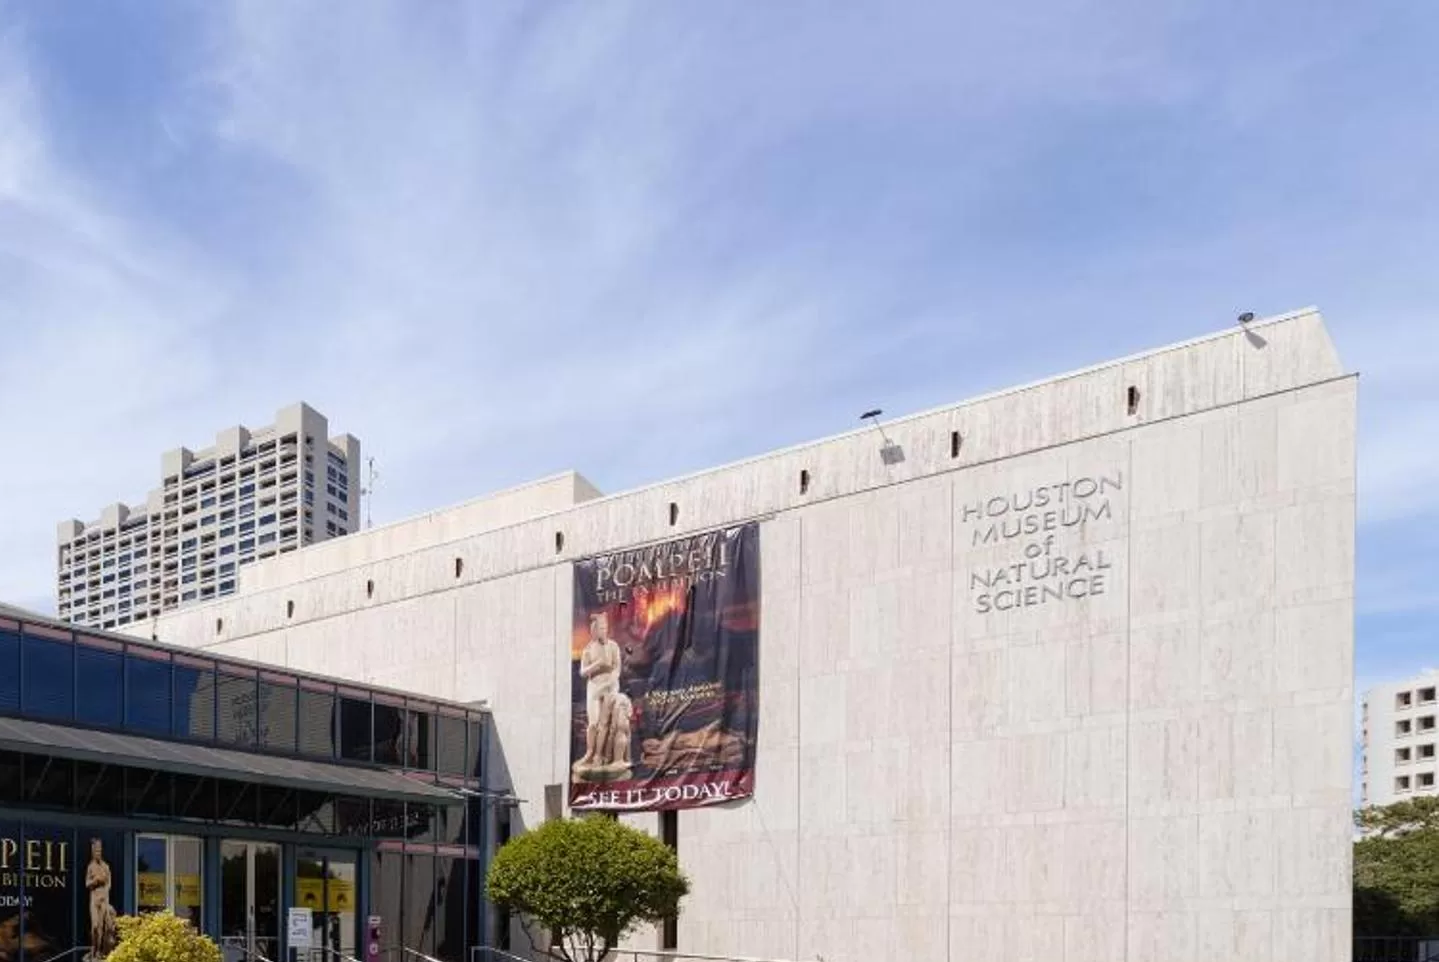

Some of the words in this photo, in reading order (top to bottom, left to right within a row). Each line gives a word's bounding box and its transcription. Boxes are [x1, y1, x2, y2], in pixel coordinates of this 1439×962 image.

[962, 471, 1122, 522] HOUSTON
[972, 500, 1112, 546] MUSEUM
[1025, 535, 1054, 559] of
[971, 550, 1112, 590] NATURAL
[976, 575, 1106, 613] SCIENCE
[627, 789, 647, 804] IT
